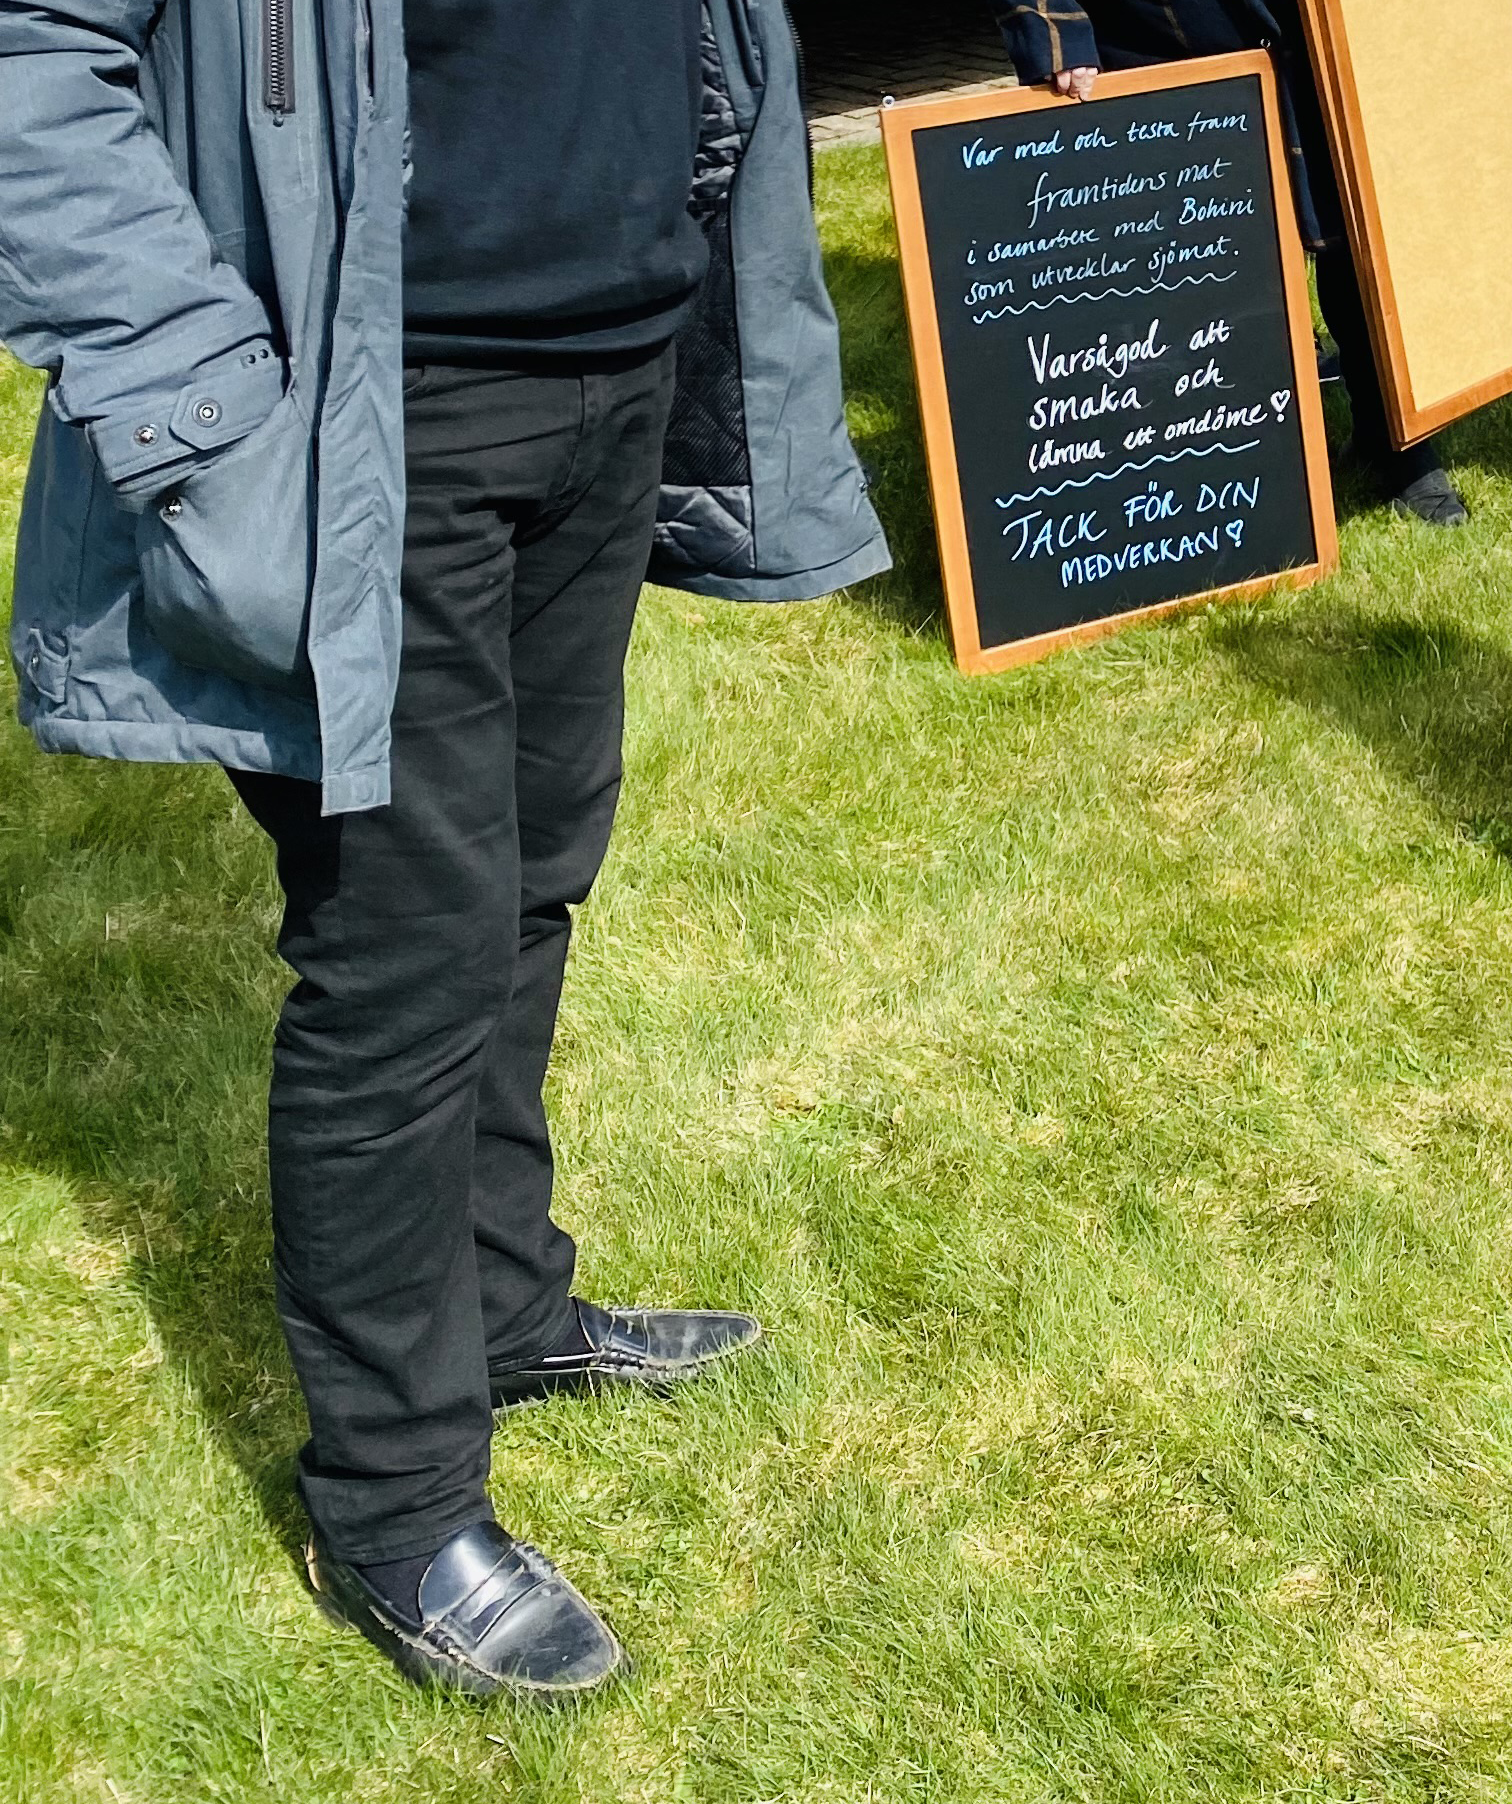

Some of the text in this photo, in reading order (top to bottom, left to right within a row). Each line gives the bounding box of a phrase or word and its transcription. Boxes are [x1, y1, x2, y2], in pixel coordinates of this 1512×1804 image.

[962, 111, 1248, 169] Var med och testa fram
[1027, 157, 1232, 229] framtidens mat
[966, 239, 977, 265] i
[987, 228, 1100, 263] samarbete
[1114, 211, 1164, 237] med
[964, 278, 1014, 305] som
[1032, 253, 1136, 290] utvecklar
[1027, 318, 1235, 385] Varsågod att
[1027, 358, 1236, 430] smaka och
[1028, 439, 1111, 473] lämna
[1123, 426, 1157, 450] ett
[1002, 476, 1260, 561] TACK FÖR DIN
